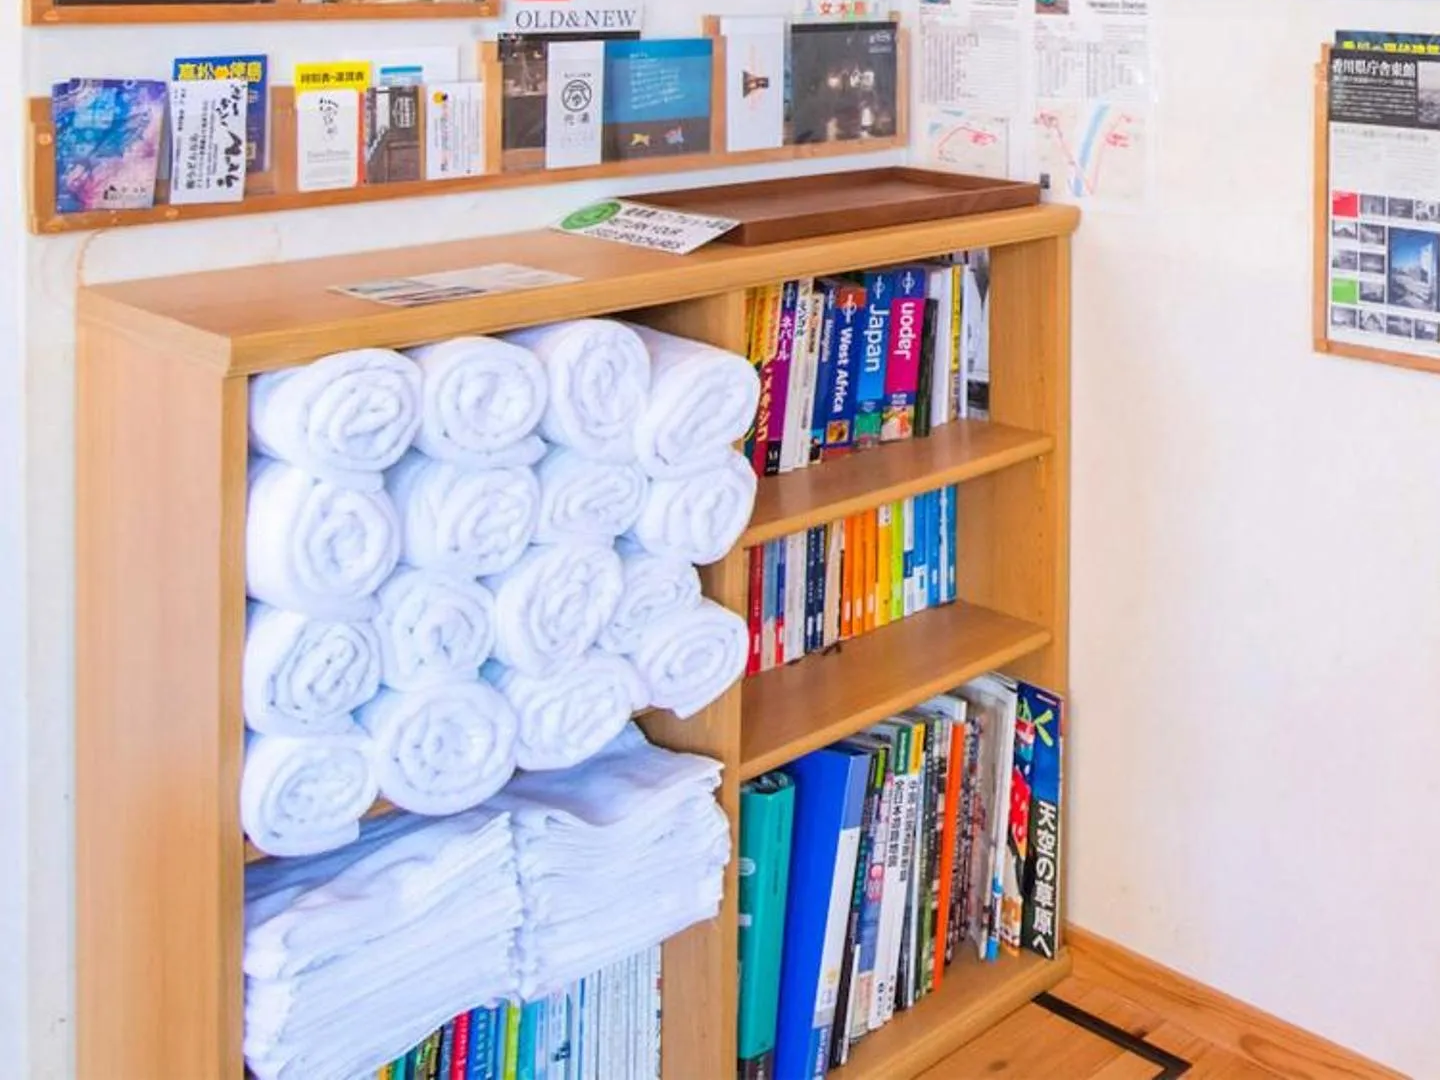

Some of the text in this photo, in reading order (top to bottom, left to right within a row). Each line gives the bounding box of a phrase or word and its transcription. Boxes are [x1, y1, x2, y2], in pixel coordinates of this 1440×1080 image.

[515, 8, 637, 29] OLD&NEW
[1332, 58, 1416, 78] 香川県庁舎東館
[863, 304, 889, 372] Japan
[831, 326, 852, 414] West Africa
